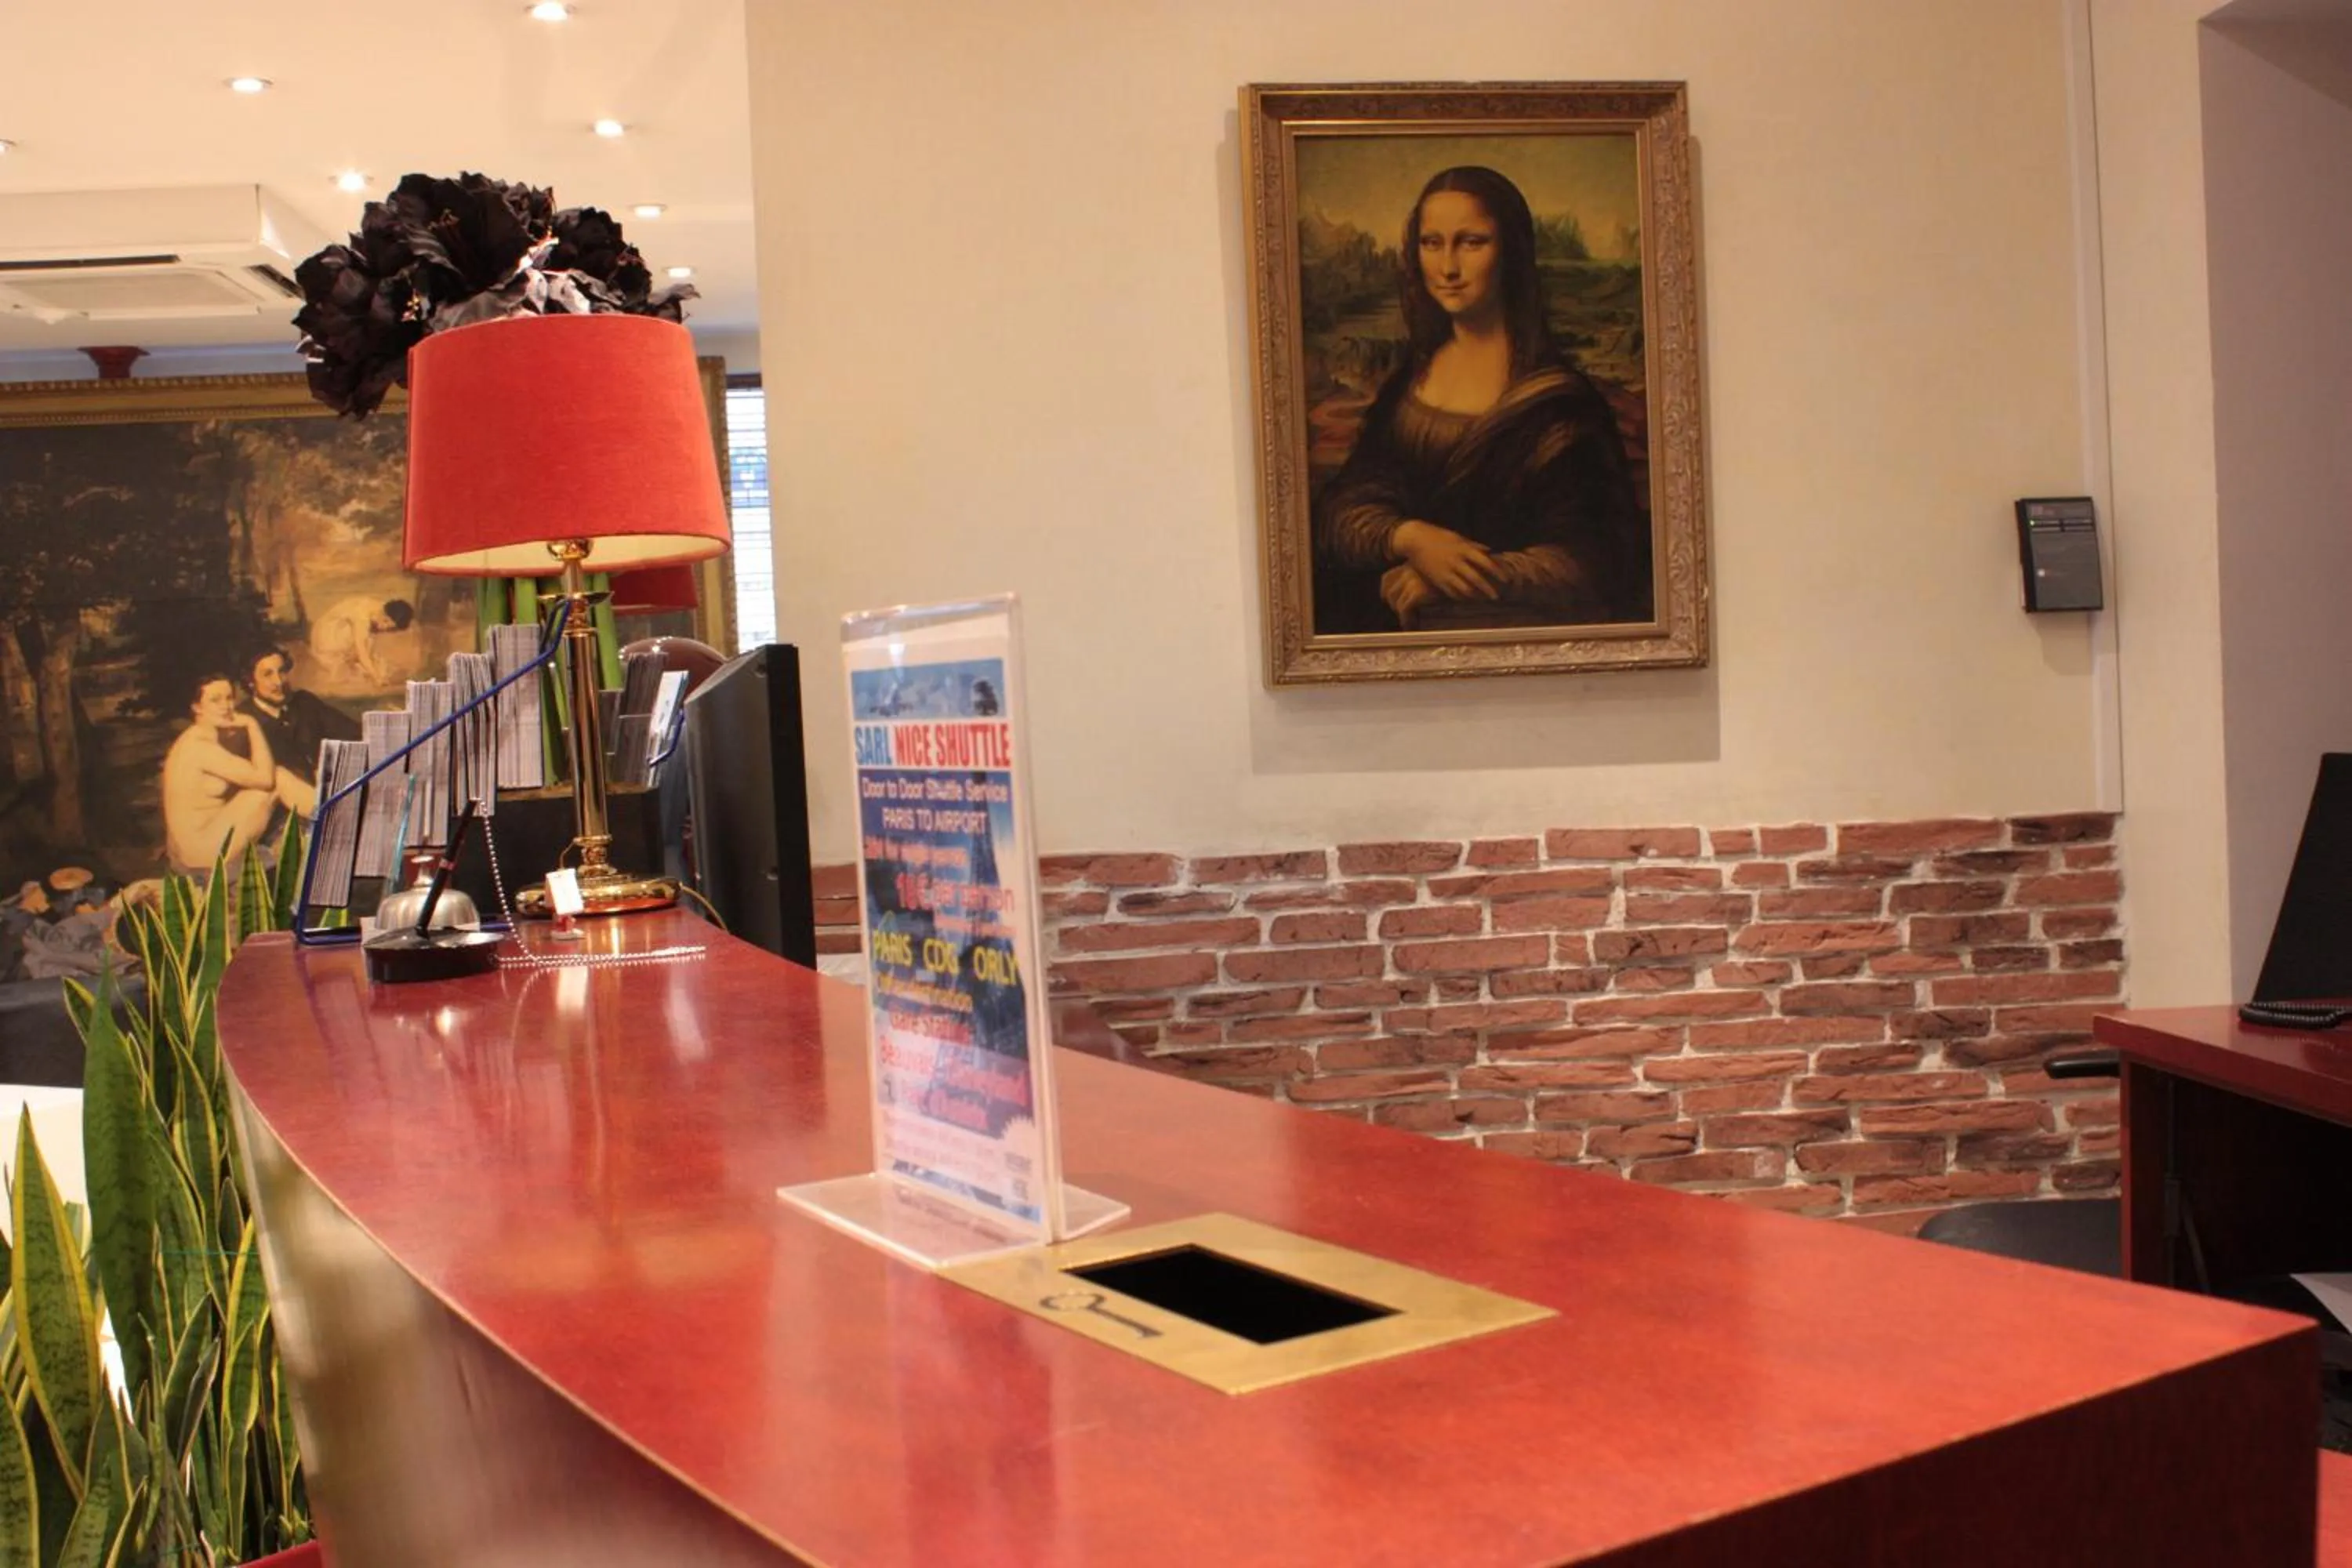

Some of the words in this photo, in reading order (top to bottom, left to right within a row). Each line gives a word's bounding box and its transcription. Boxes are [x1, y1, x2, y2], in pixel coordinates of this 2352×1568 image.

[855, 725, 892, 765] SARL
[895, 724, 933, 766] NICE
[935, 723, 1011, 767] SHUTTLE
[862, 777, 885, 798] Door
[887, 779, 898, 799] to
[898, 778, 924, 800] Door
[925, 778, 963, 801] Shuttle
[965, 779, 1008, 803] Service
[882, 807, 915, 830] PARIS
[916, 808, 932, 832] TO
[934, 810, 987, 834] AIRPORT
[872, 928, 913, 967] PARIS
[923, 938, 960, 976] CDG
[973, 946, 1022, 986] ORLY
